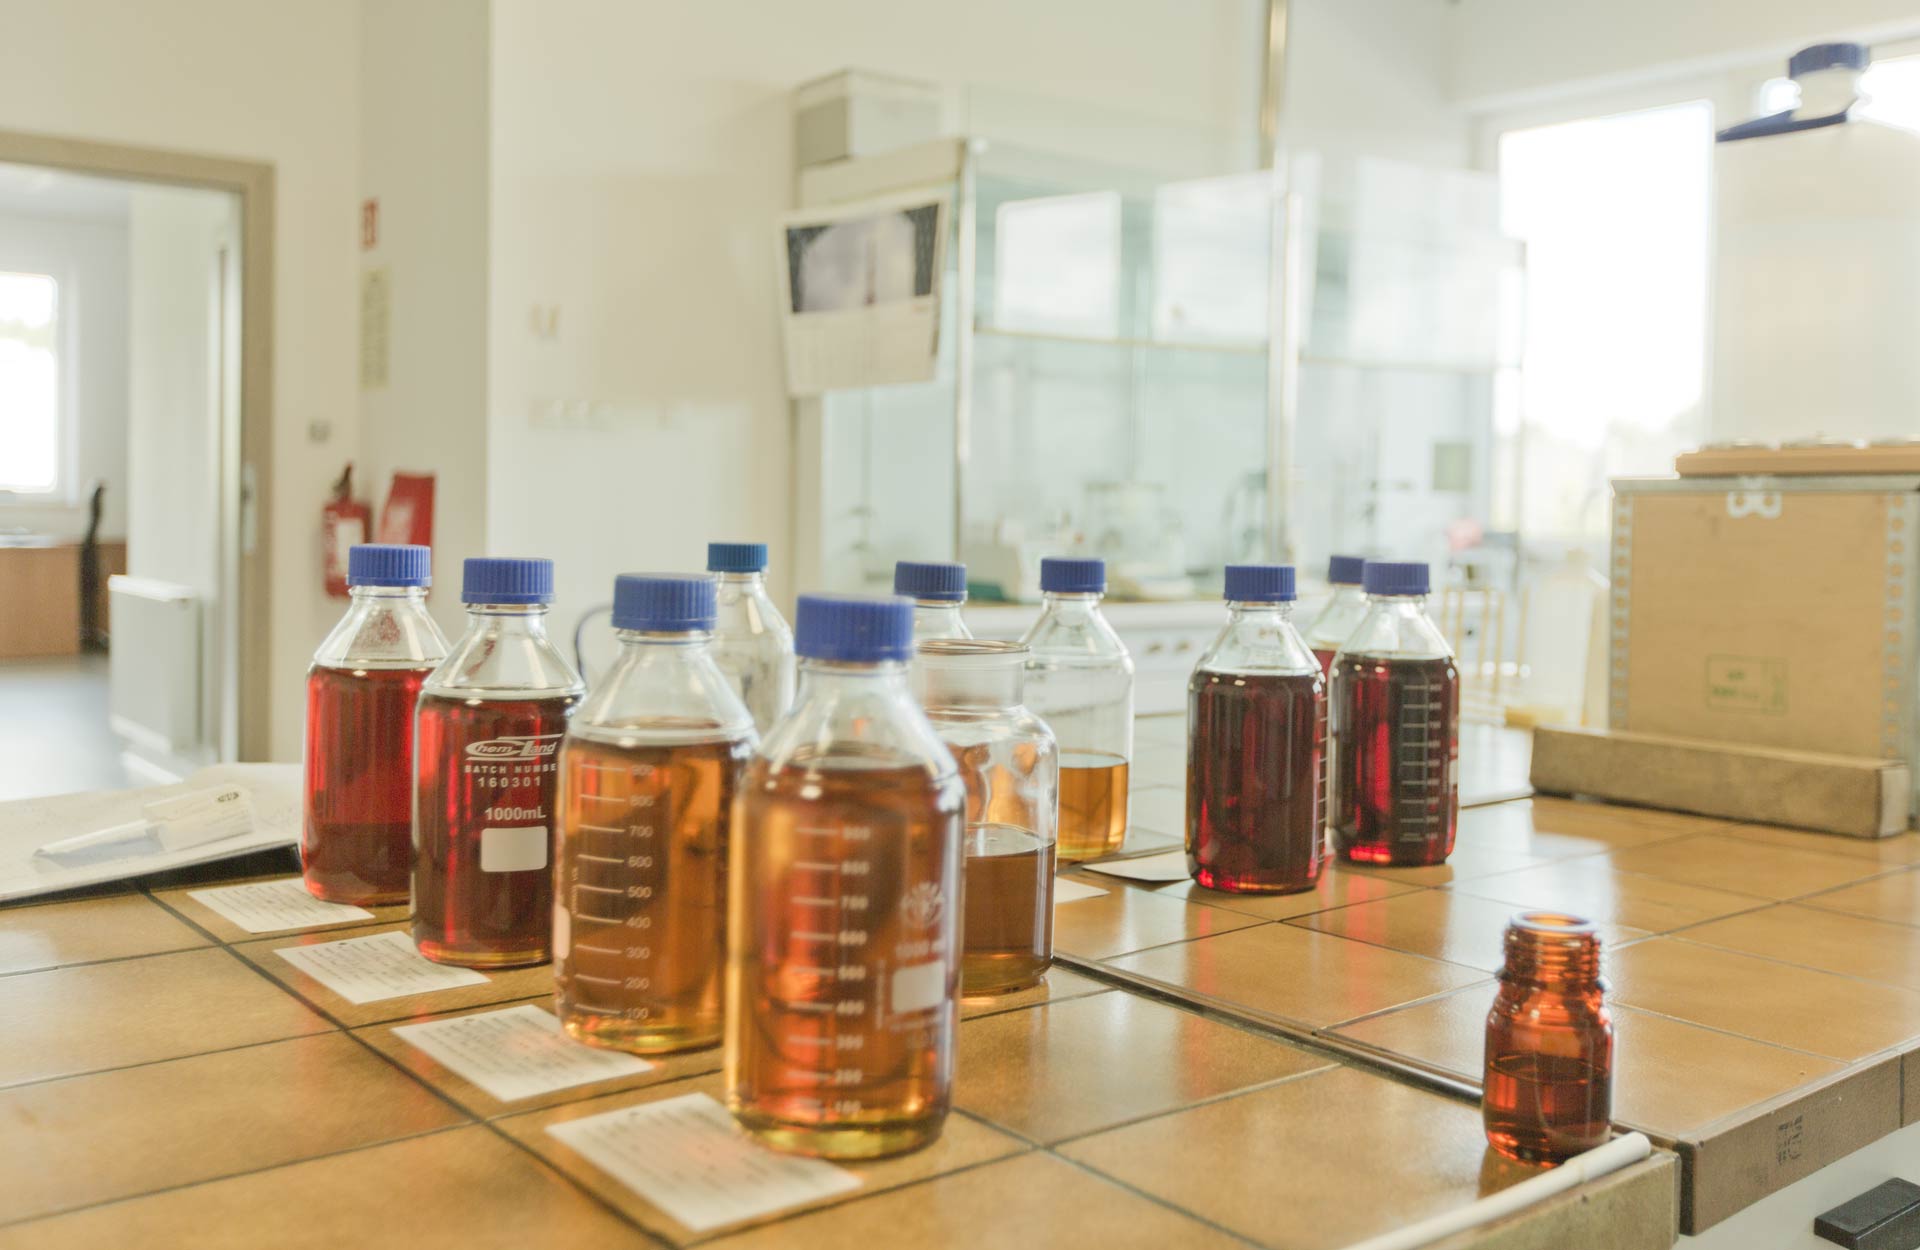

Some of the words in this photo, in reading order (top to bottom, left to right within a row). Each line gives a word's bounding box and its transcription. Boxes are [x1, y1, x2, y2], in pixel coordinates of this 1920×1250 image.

[464, 764, 507, 774] BATCH
[514, 763, 557, 774] NUMBE
[477, 776, 541, 788] 160301
[629, 825, 654, 838] 700
[628, 855, 653, 868] 600
[627, 885, 652, 898] 500
[626, 916, 651, 929] 400
[625, 946, 651, 960] 300
[624, 976, 650, 990] 200
[625, 1007, 649, 1020] 100
